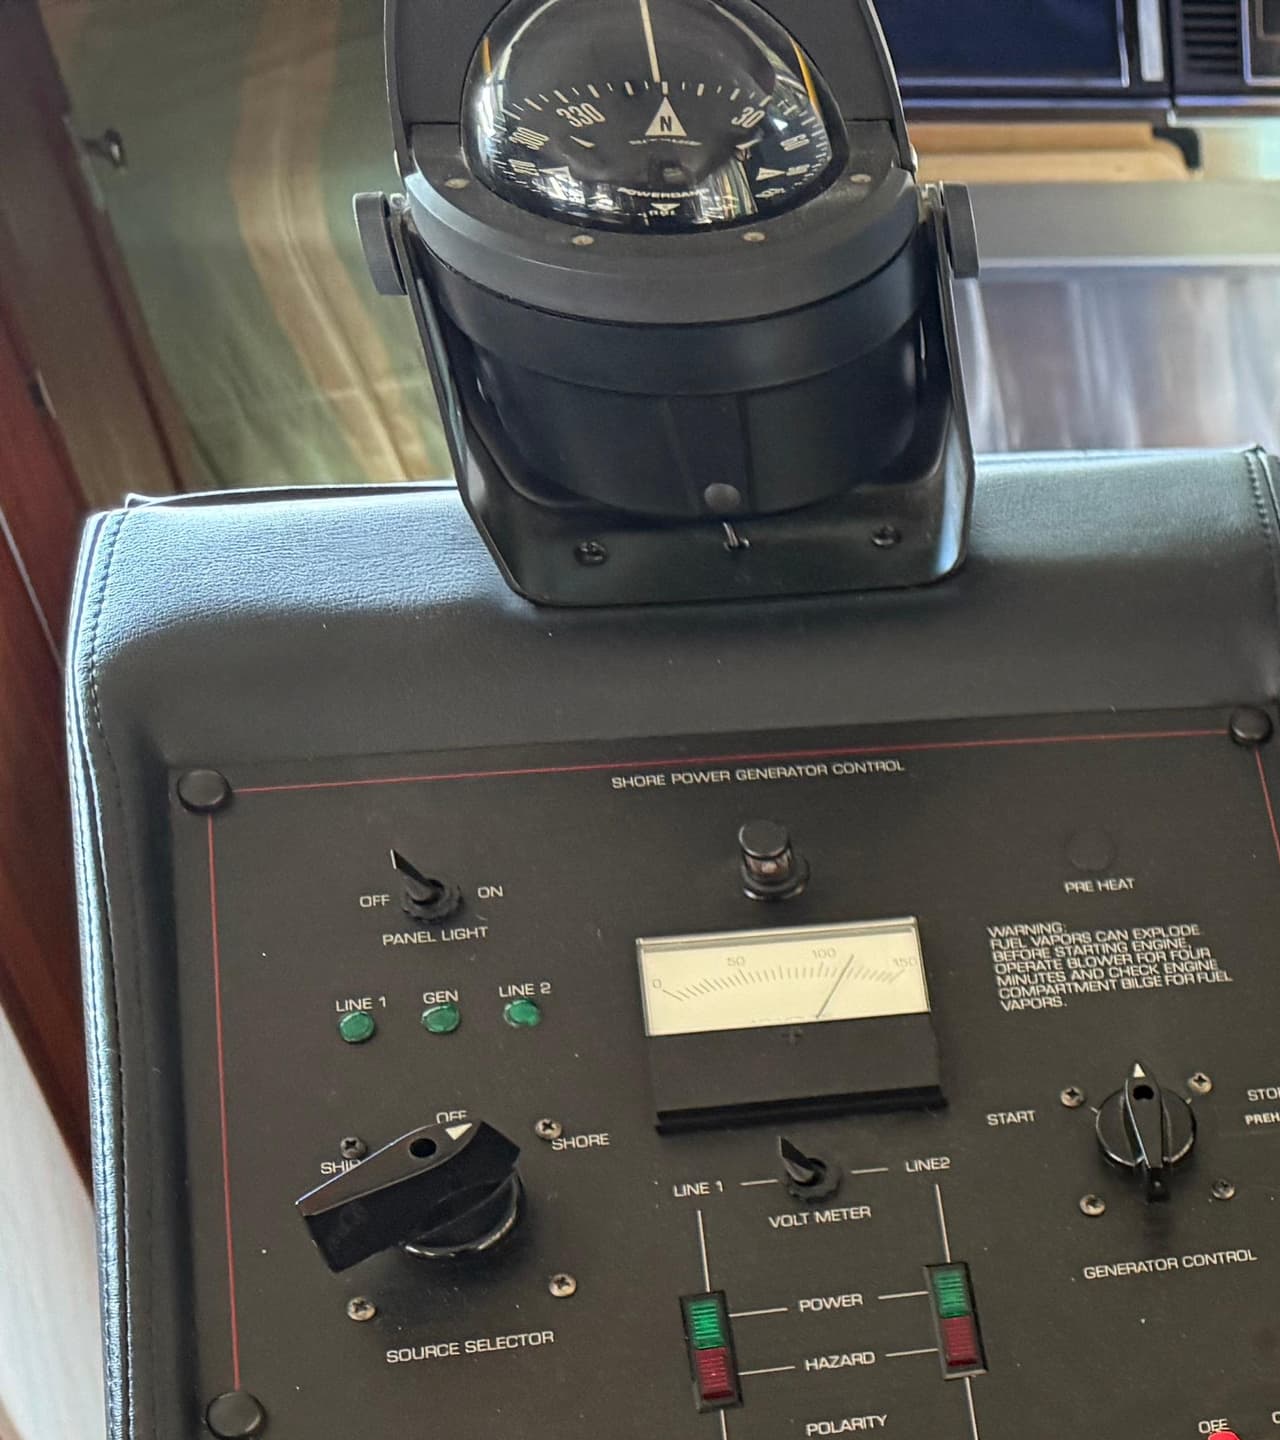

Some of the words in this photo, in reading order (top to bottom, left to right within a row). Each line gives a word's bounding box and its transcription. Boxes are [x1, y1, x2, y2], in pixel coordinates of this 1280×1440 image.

[557, 104, 604, 127] 330
[660, 117, 673, 131] N
[732, 107, 765, 128] 30
[612, 776, 666, 789] SHORE
[672, 770, 731, 785] POWER
[736, 764, 828, 781] GENERATOR
[833, 759, 905, 775] CONTROL
[1063, 880, 1094, 894] PRE
[1099, 877, 1136, 891] HEAT
[359, 894, 391, 908] OFF
[477, 885, 504, 899] ON
[383, 930, 436, 945] PANEL
[441, 926, 489, 942] LIGHT
[987, 922, 1067, 938] WARNING:
[990, 936, 1027, 951] FUEL
[1030, 931, 1092, 948] VAPORS
[1095, 928, 1129, 943] CAN
[992, 948, 1051, 963] BEFORE
[1054, 942, 1128, 959] STARTING
[423, 990, 459, 1004] GEN
[499, 983, 535, 998] LINE
[540, 982, 552, 995] 2
[335, 998, 372, 1012] LINE
[378, 996, 386, 1008] 1
[986, 1110, 1036, 1126] START
[551, 1133, 610, 1151] SHORE
[905, 1157, 951, 1173] LINE2
[673, 1182, 710, 1198] LINE
[715, 1180, 724, 1193] 1
[768, 1211, 809, 1229] VOLT
[815, 1206, 871, 1224] METER
[1084, 1257, 1179, 1281] GENERATOR
[1182, 1249, 1258, 1270] CONTROL
[799, 1293, 864, 1313] POWER
[386, 1342, 460, 1364] SOURCE
[464, 1331, 555, 1354] SELECTOR
[805, 1351, 876, 1371] HAZARD
[806, 1414, 888, 1437] POLARITY
